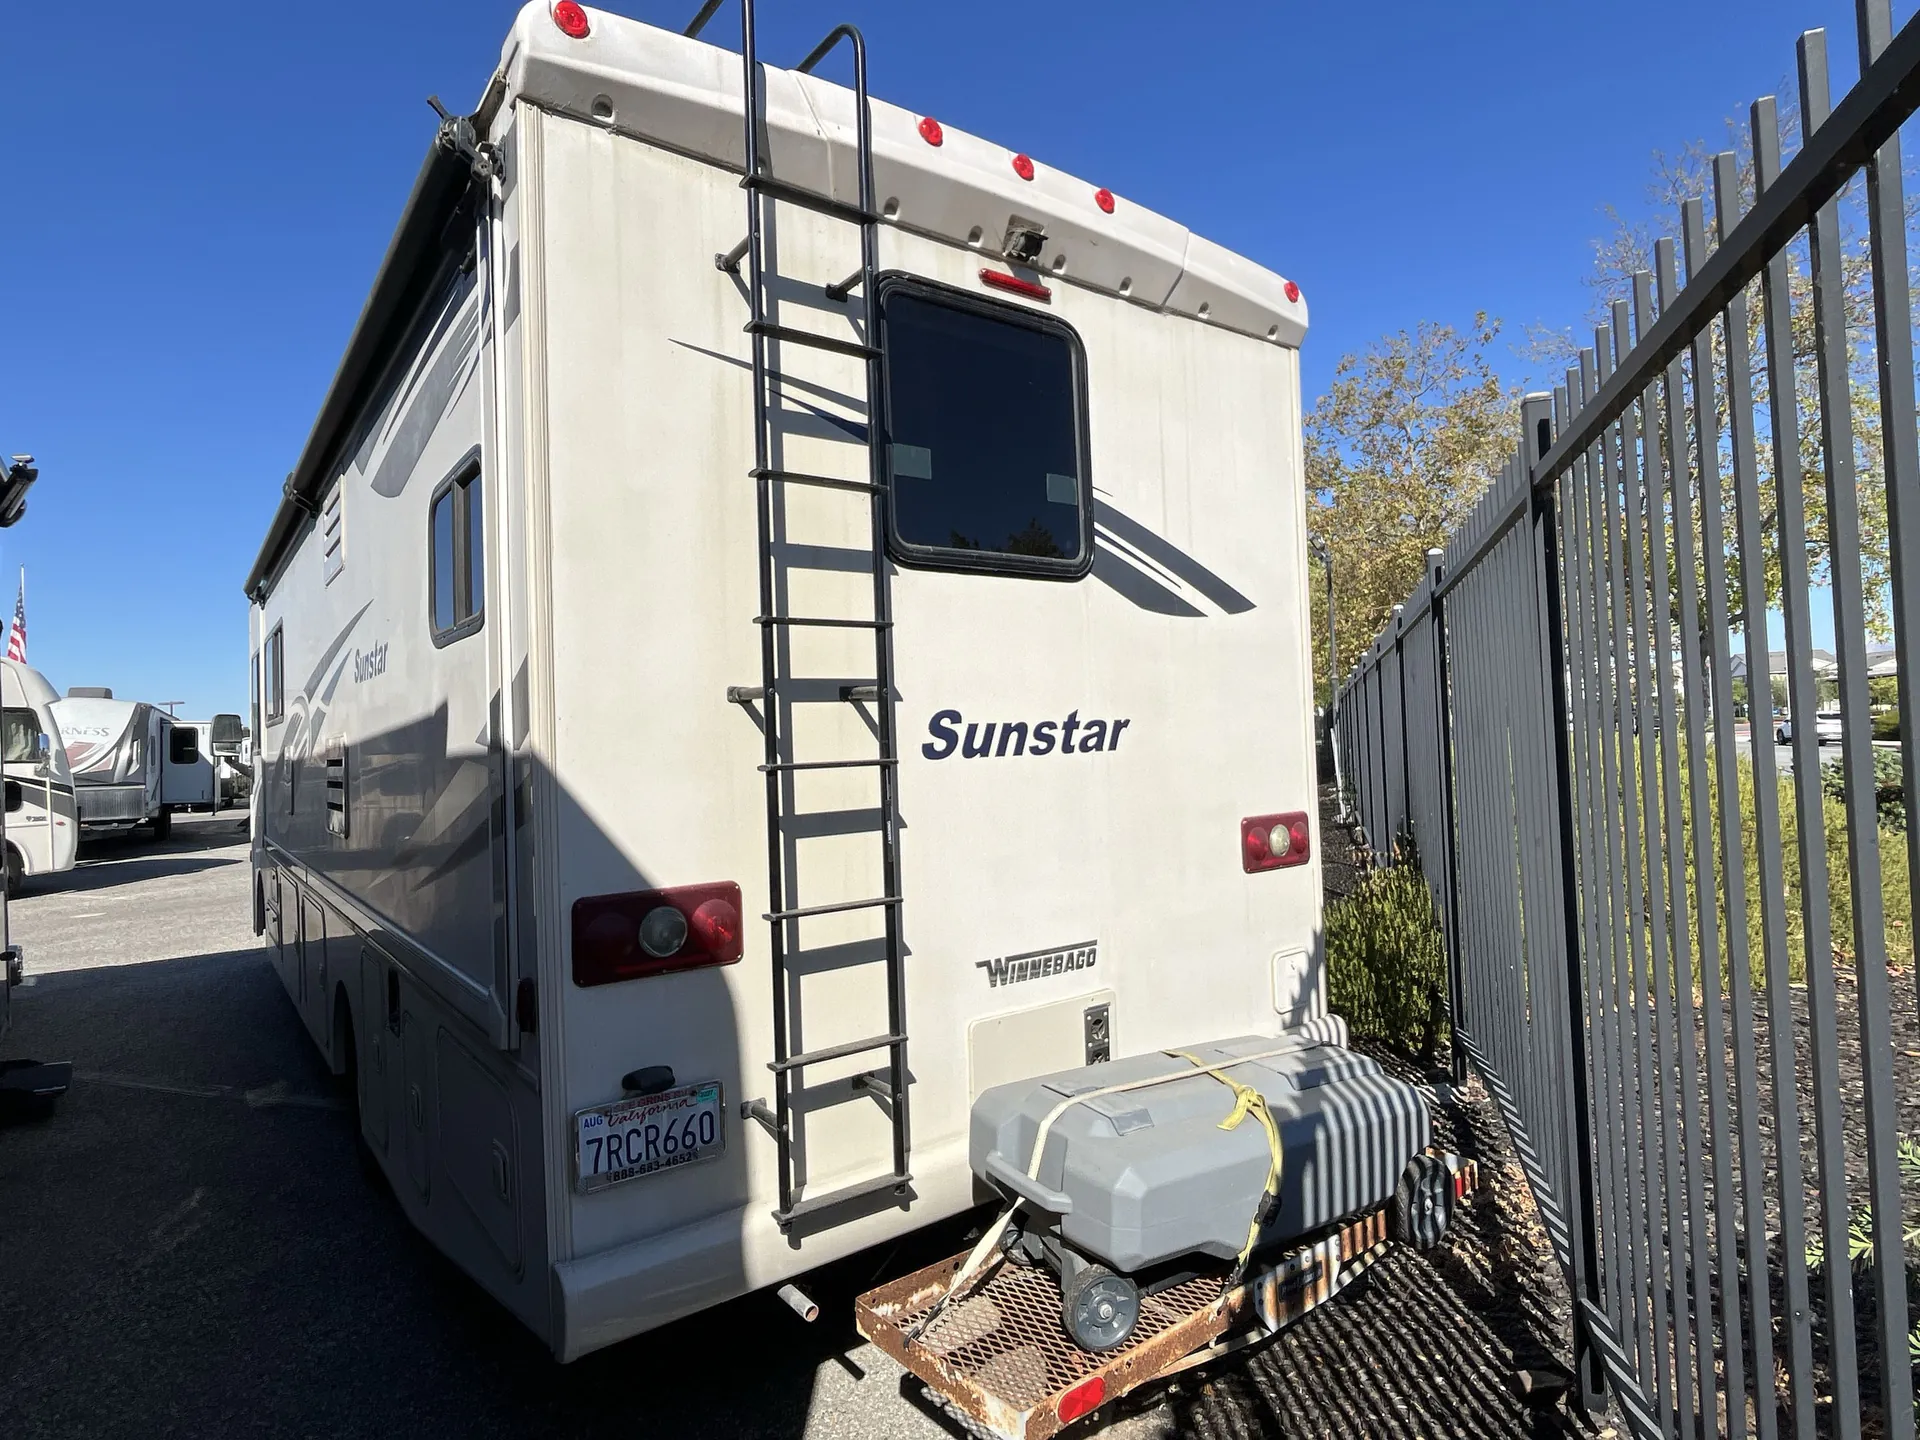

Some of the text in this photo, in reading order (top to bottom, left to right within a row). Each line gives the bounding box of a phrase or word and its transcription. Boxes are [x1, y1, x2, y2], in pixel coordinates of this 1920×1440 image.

[354, 639, 389, 684] Sunstar
[921, 708, 1131, 761] Sunstar
[975, 939, 1098, 988] WINNEBAGO
[583, 1115, 603, 1129] AUG
[607, 1098, 698, 1129] California
[586, 1110, 715, 1174] 7RCR660
